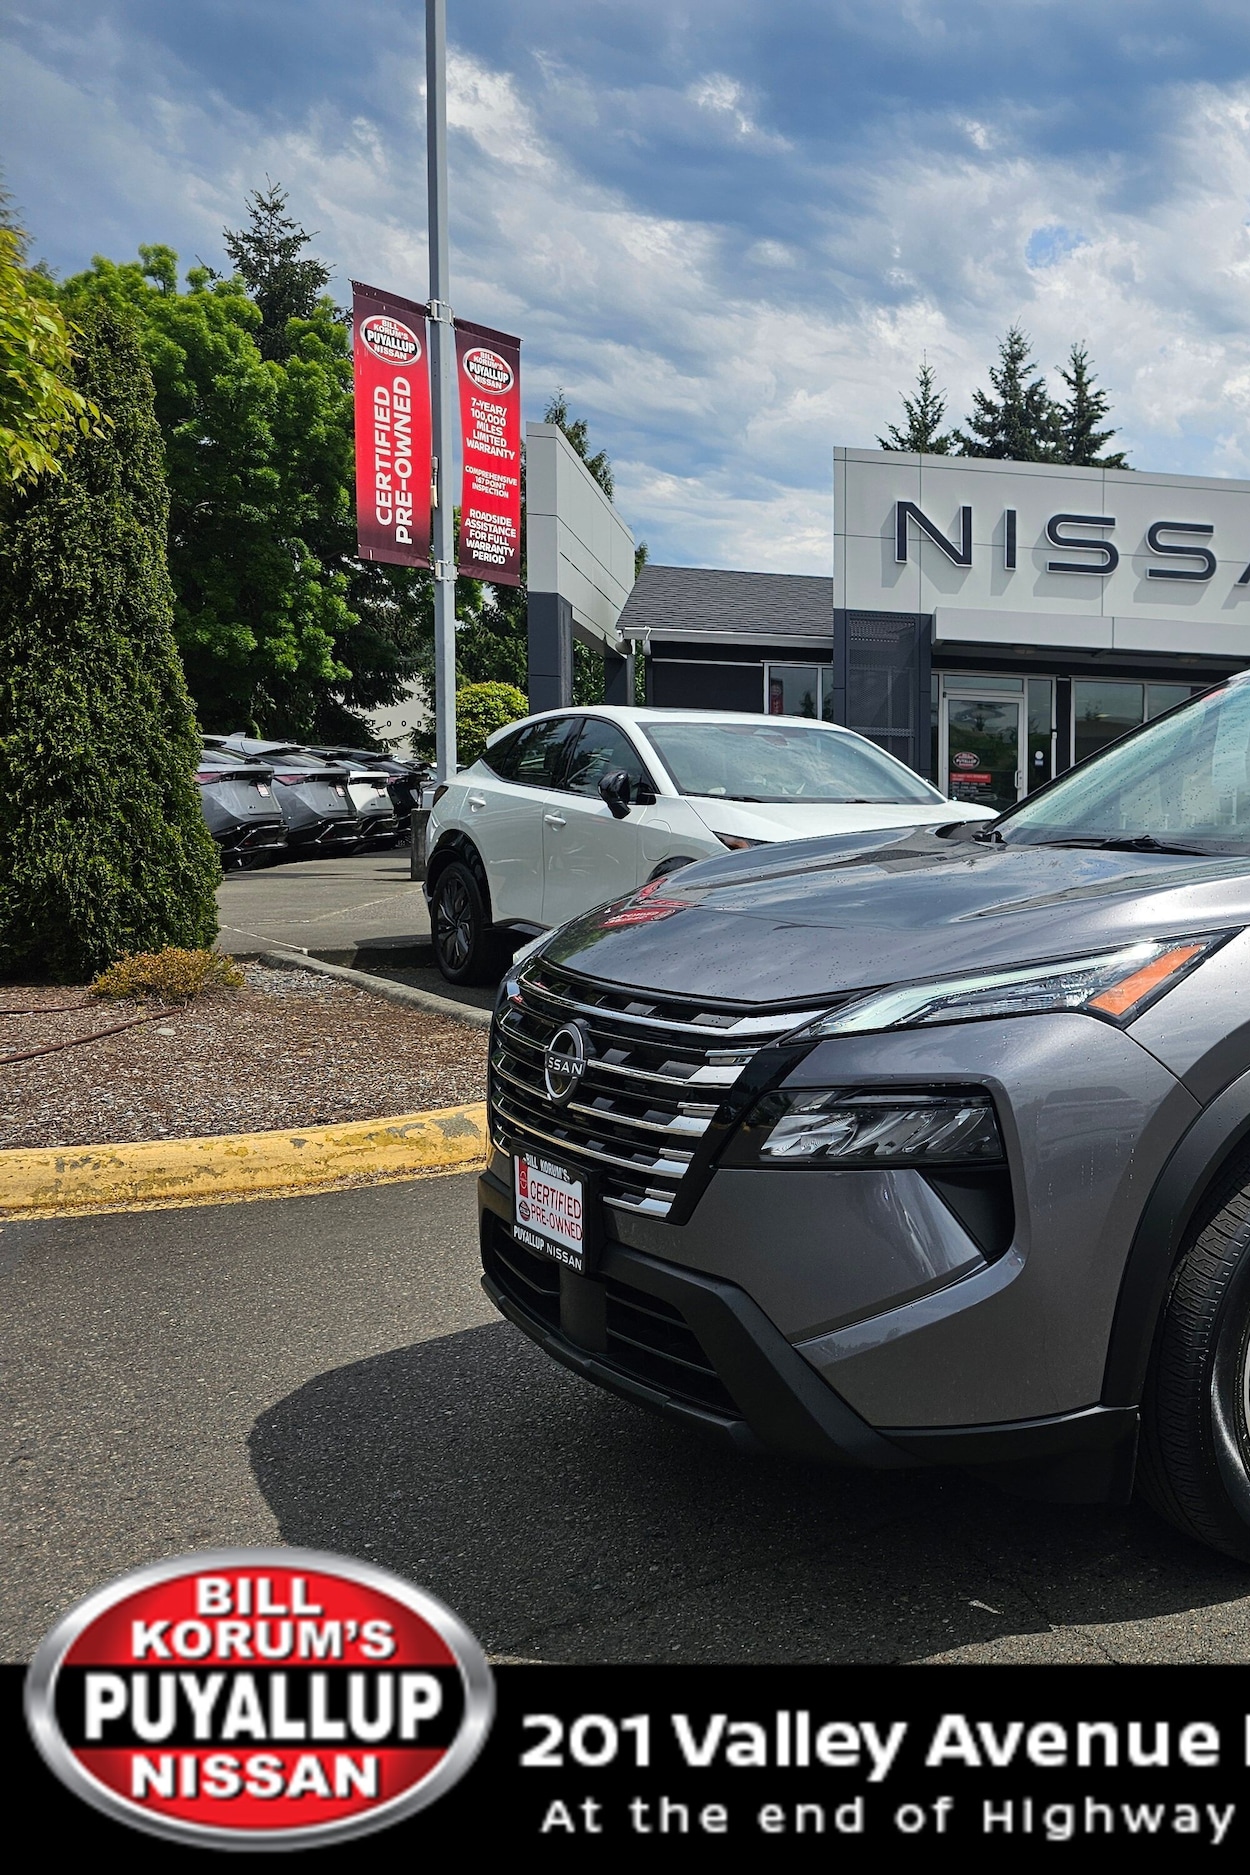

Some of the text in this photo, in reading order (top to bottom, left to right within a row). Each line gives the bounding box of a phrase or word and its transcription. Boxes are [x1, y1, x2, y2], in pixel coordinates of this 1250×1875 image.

[373, 323, 409, 340] KORUM'S
[381, 320, 399, 331] BILL
[366, 330, 416, 354] PUYALLUP
[374, 344, 408, 360] NISSAN
[473, 354, 504, 371] KORUM'S
[480, 351, 496, 362] BILL
[469, 361, 509, 383] PUYALLUP
[474, 374, 503, 390] NISSAN
[470, 396, 508, 418] 7-YEAR/
[470, 407, 507, 427] 100,000
[472, 428, 507, 448] LIMITED
[476, 420, 503, 436] MILES
[373, 385, 393, 526] CERTIFIED
[466, 437, 515, 460] WARRANTY
[392, 376, 413, 545] PRE-OWNED
[464, 465, 518, 486] COMPREHENSIVE
[485, 478, 506, 490] POINT
[471, 482, 509, 498] INSPECTION
[464, 517, 517, 539] ASSISTANCE
[469, 508, 513, 528] ROADSIDE
[465, 537, 515, 557] WARRANTY
[469, 529, 510, 547] FOR FULL
[472, 550, 506, 565] PERIOD
[547, 1056, 584, 1075] SSAN
[525, 1153, 570, 1182] BILL KORUM'S
[530, 1180, 582, 1220] CERTIFIED
[530, 1203, 583, 1241] PRE-OWNED
[513, 1225, 582, 1271] PUYALLUP NISSAN
